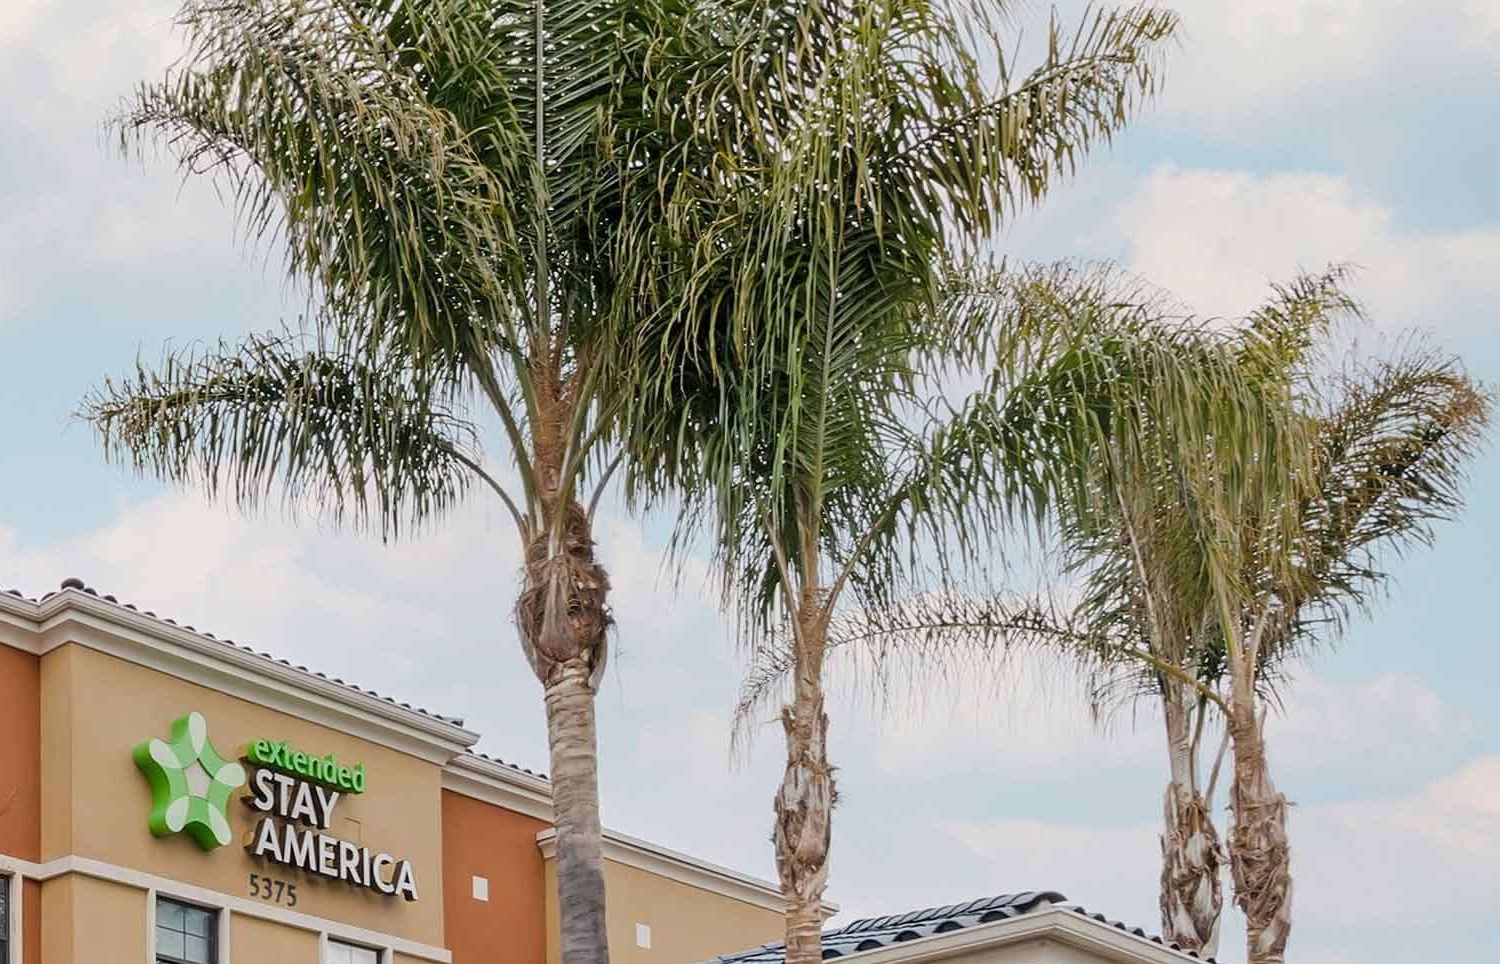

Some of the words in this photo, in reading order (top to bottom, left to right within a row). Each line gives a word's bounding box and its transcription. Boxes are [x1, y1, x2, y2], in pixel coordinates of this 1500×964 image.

[253, 738, 366, 794] extended
[253, 768, 340, 829] STAY
[255, 817, 419, 900] AMERICA
[249, 873, 298, 907] 5375
